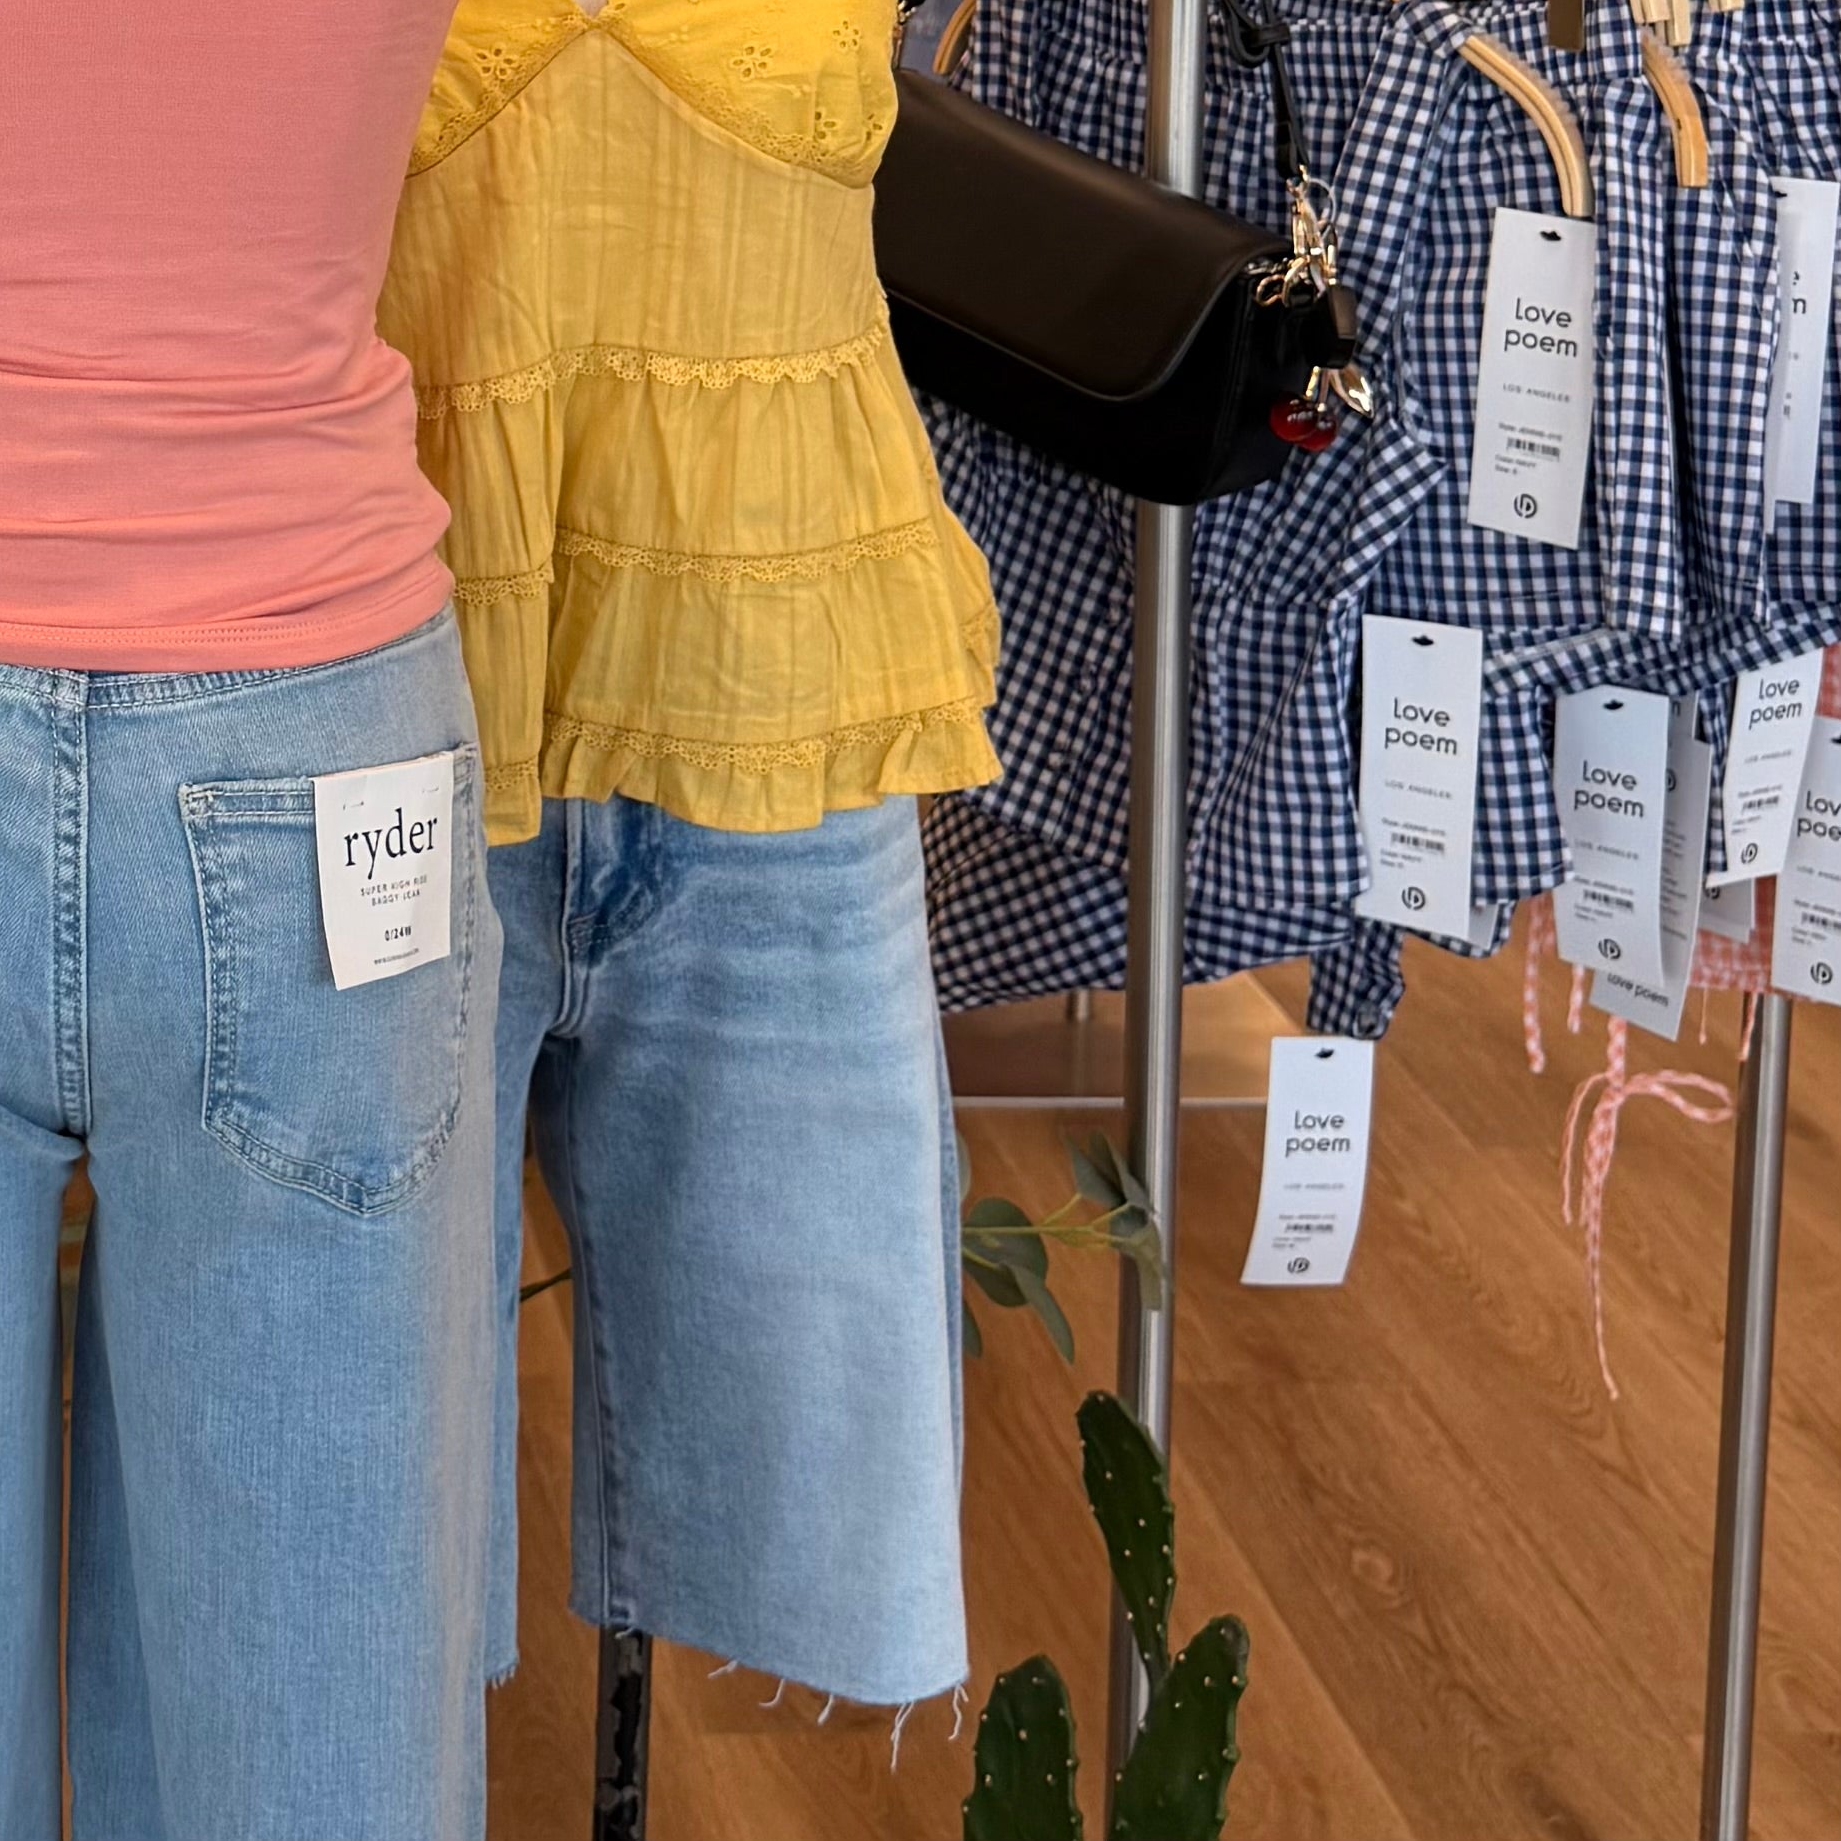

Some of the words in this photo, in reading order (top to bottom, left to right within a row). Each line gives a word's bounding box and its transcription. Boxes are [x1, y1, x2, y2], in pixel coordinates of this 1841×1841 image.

[1504, 329, 1577, 357] poem
[1749, 702, 1802, 731] poem
[1384, 727, 1457, 755] poem
[1574, 789, 1644, 818] poem
[344, 807, 437, 880] ryder
[1796, 818, 1841, 842] poe
[361, 883, 387, 897] SUPER
[1285, 1137, 1350, 1158] poem
